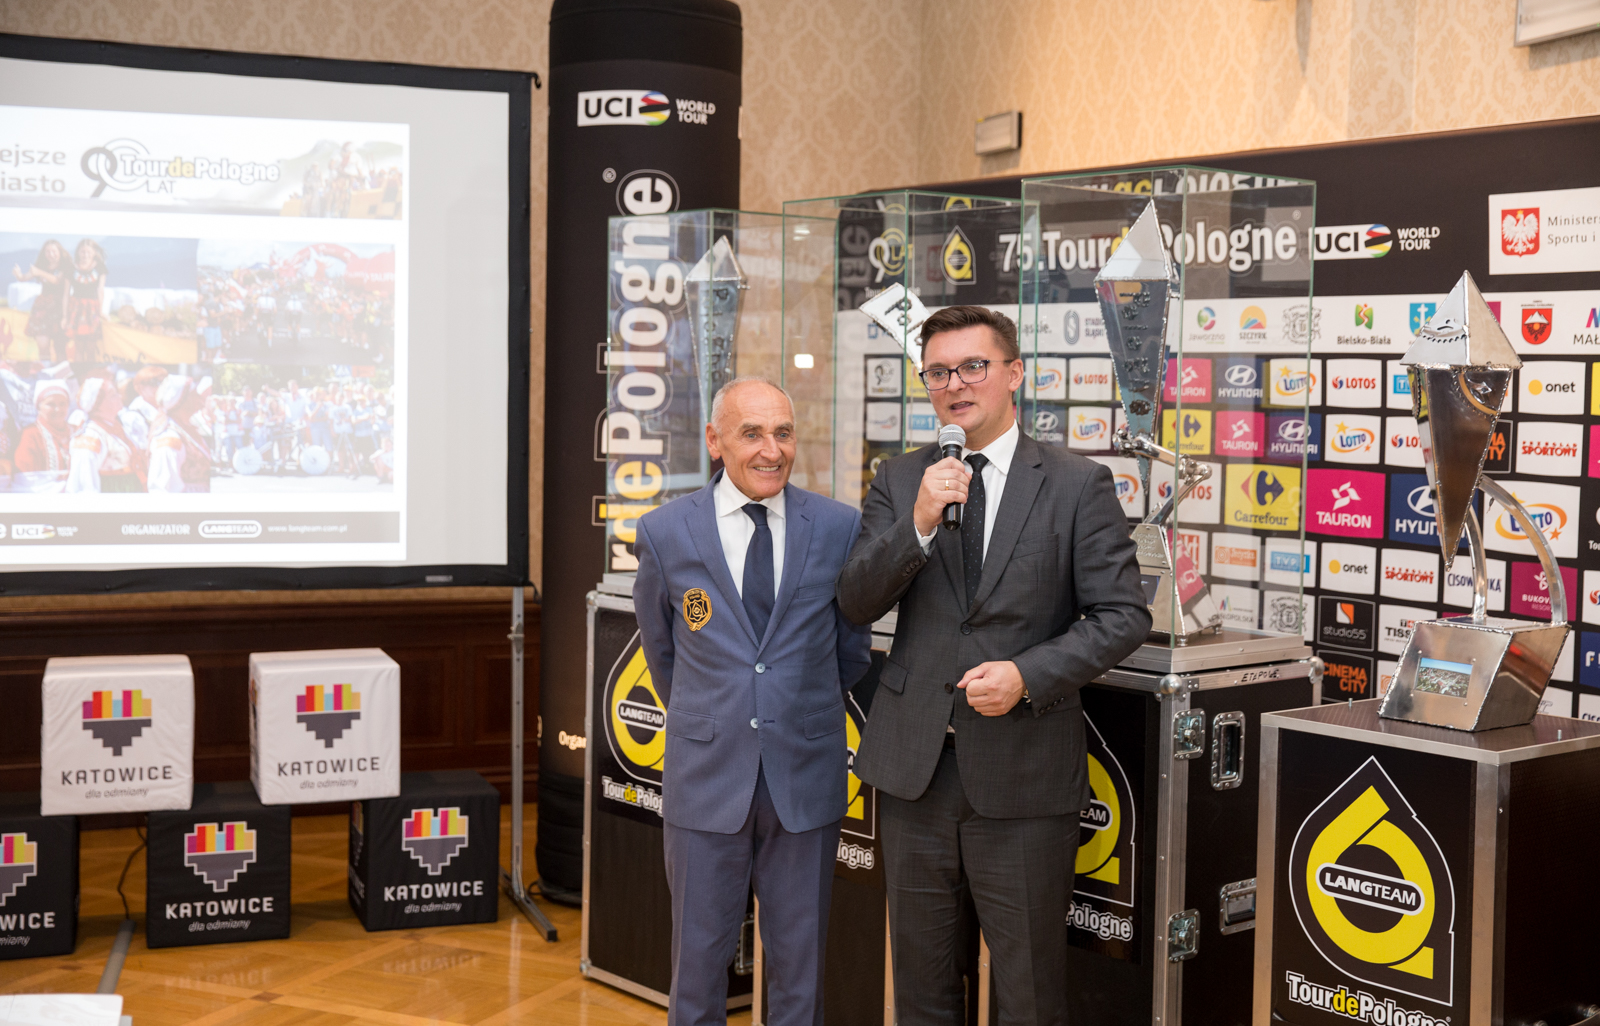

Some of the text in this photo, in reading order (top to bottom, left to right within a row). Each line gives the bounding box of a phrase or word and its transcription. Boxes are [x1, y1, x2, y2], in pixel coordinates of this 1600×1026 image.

[584, 97, 632, 117] UCI
[676, 99, 716, 115] WORLD
[677, 110, 708, 125] TOUR
[1, 171, 66, 193] iasto
[146, 180, 177, 194] LAT
[1397, 226, 1440, 240] WORLD
[1547, 231, 1597, 247] Sportu i
[1315, 231, 1359, 254] UCI
[1399, 238, 1431, 252] TOUR
[1337, 335, 1391, 345] Bielsko-Biała
[1084, 374, 1108, 385] LOTOS
[1346, 377, 1376, 389] LOTOS
[1218, 387, 1264, 398] HYUNDAI
[1545, 381, 1576, 393] onet
[1221, 440, 1258, 451] TAURON
[1340, 433, 1367, 448] LOTTO
[1521, 446, 1577, 457] SPORTOWY
[1234, 509, 1289, 526] Carrefour
[1316, 511, 1372, 529] TAURON
[16, 528, 39, 536] UCI
[121, 524, 190, 536] ORGANIZATOR
[1343, 564, 1368, 575] onet
[1322, 626, 1367, 641] studio55
[1339, 677, 1368, 694] CITY
[620, 705, 664, 725] LANGTEAM
[277, 756, 380, 777] KATOWICE
[61, 765, 173, 786] KATOWICE
[300, 780, 315, 790] dla
[85, 788, 102, 799] dla
[383, 881, 484, 902] KATOWICE
[1325, 872, 1417, 907] LANGTEAM
[166, 897, 274, 920] KATOWICE
[404, 901, 462, 914] dla odmiany
[188, 919, 251, 933] dla odmiany
